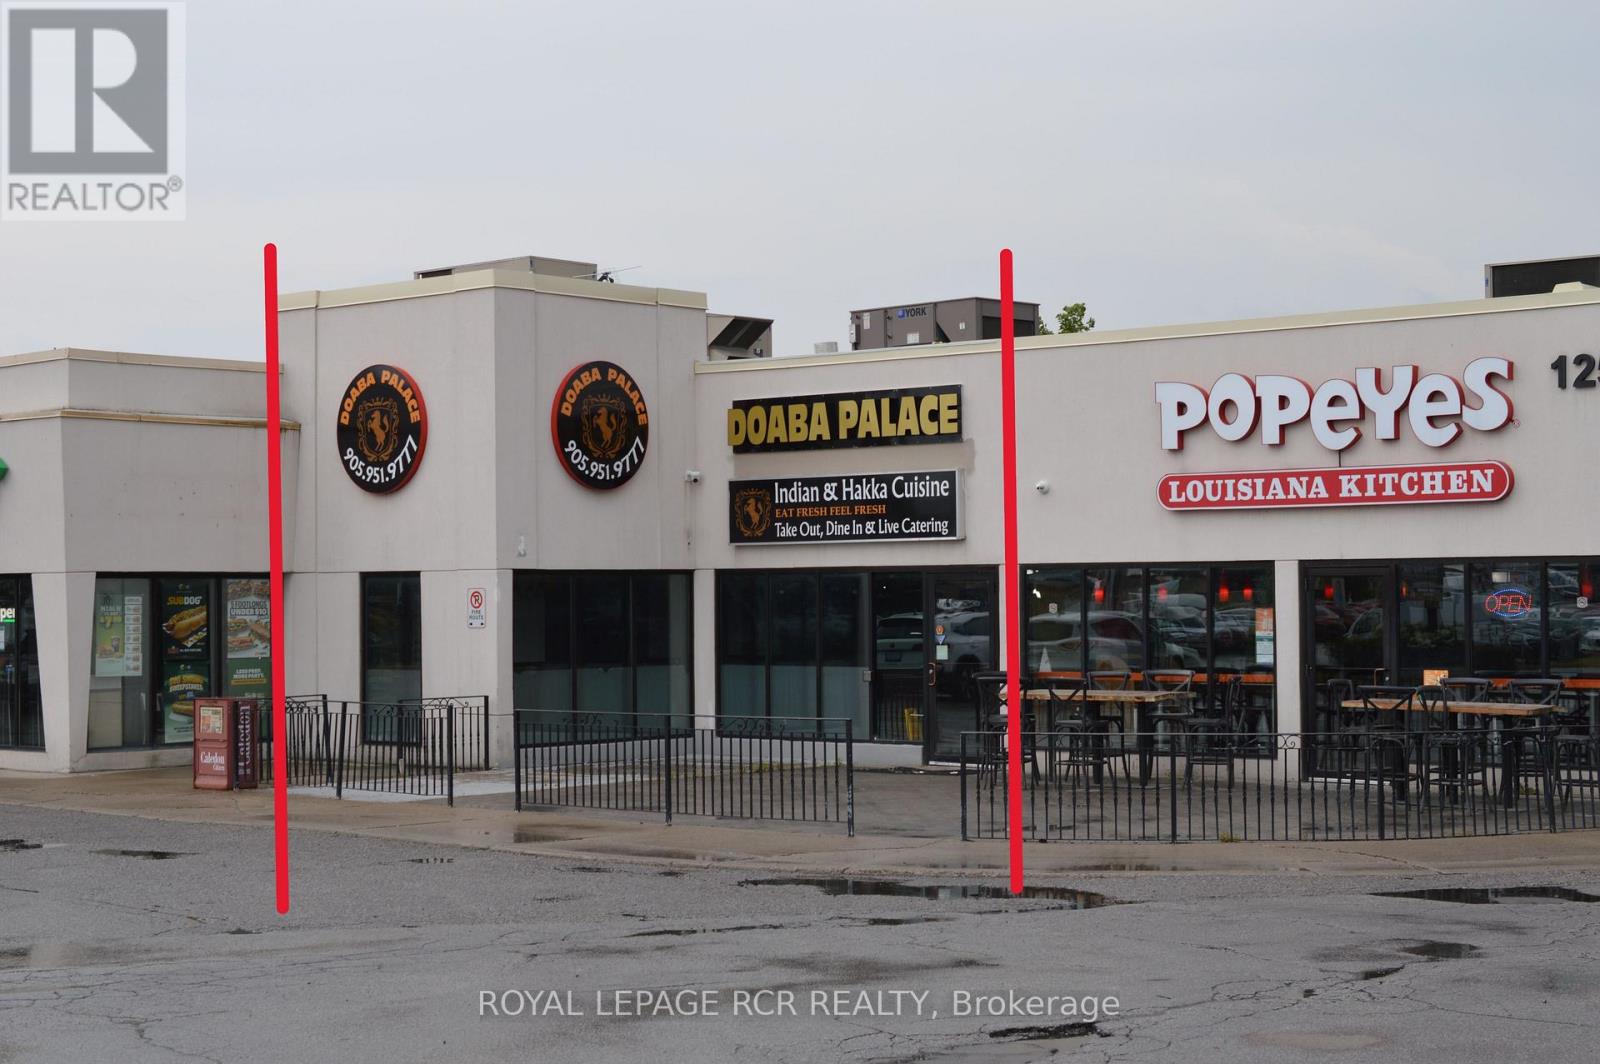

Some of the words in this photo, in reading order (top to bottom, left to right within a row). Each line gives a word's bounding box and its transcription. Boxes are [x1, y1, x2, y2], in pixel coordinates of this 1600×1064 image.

[904, 307, 926, 317] YORK
[1550, 353, 1600, 390] 12
[340, 371, 376, 425] DOABA
[381, 370, 421, 424] PALACE
[560, 367, 602, 417] DOABA
[607, 367, 649, 426] PALACE
[728, 401, 831, 446] DOABA
[838, 393, 958, 440] PALACE
[343, 434, 418, 484] 905.951.9777
[563, 435, 645, 480] 905.951.9777
[774, 481, 819, 504] Indian
[823, 481, 838, 501] &
[842, 477, 888, 501] Hakka
[892, 475, 950, 498] Cuisine
[1168, 476, 1329, 503] LOUISIANA
[1338, 468, 1495, 498] KITCHEN
[775, 507, 795, 518] EAT
[796, 506, 828, 517] FRESH
[829, 505, 853, 516] FEEL
[854, 504, 886, 515] FRESH
[775, 521, 798, 538] Take
[799, 520, 824, 539] Out,
[826, 520, 850, 536] Dine
[852, 519, 863, 535] In
[865, 519, 876, 535] &
[878, 518, 900, 534] Live
[901, 517, 949, 536] Catering
[1485, 595, 1532, 612] OPEN
[200, 751, 225, 764] Caledon
